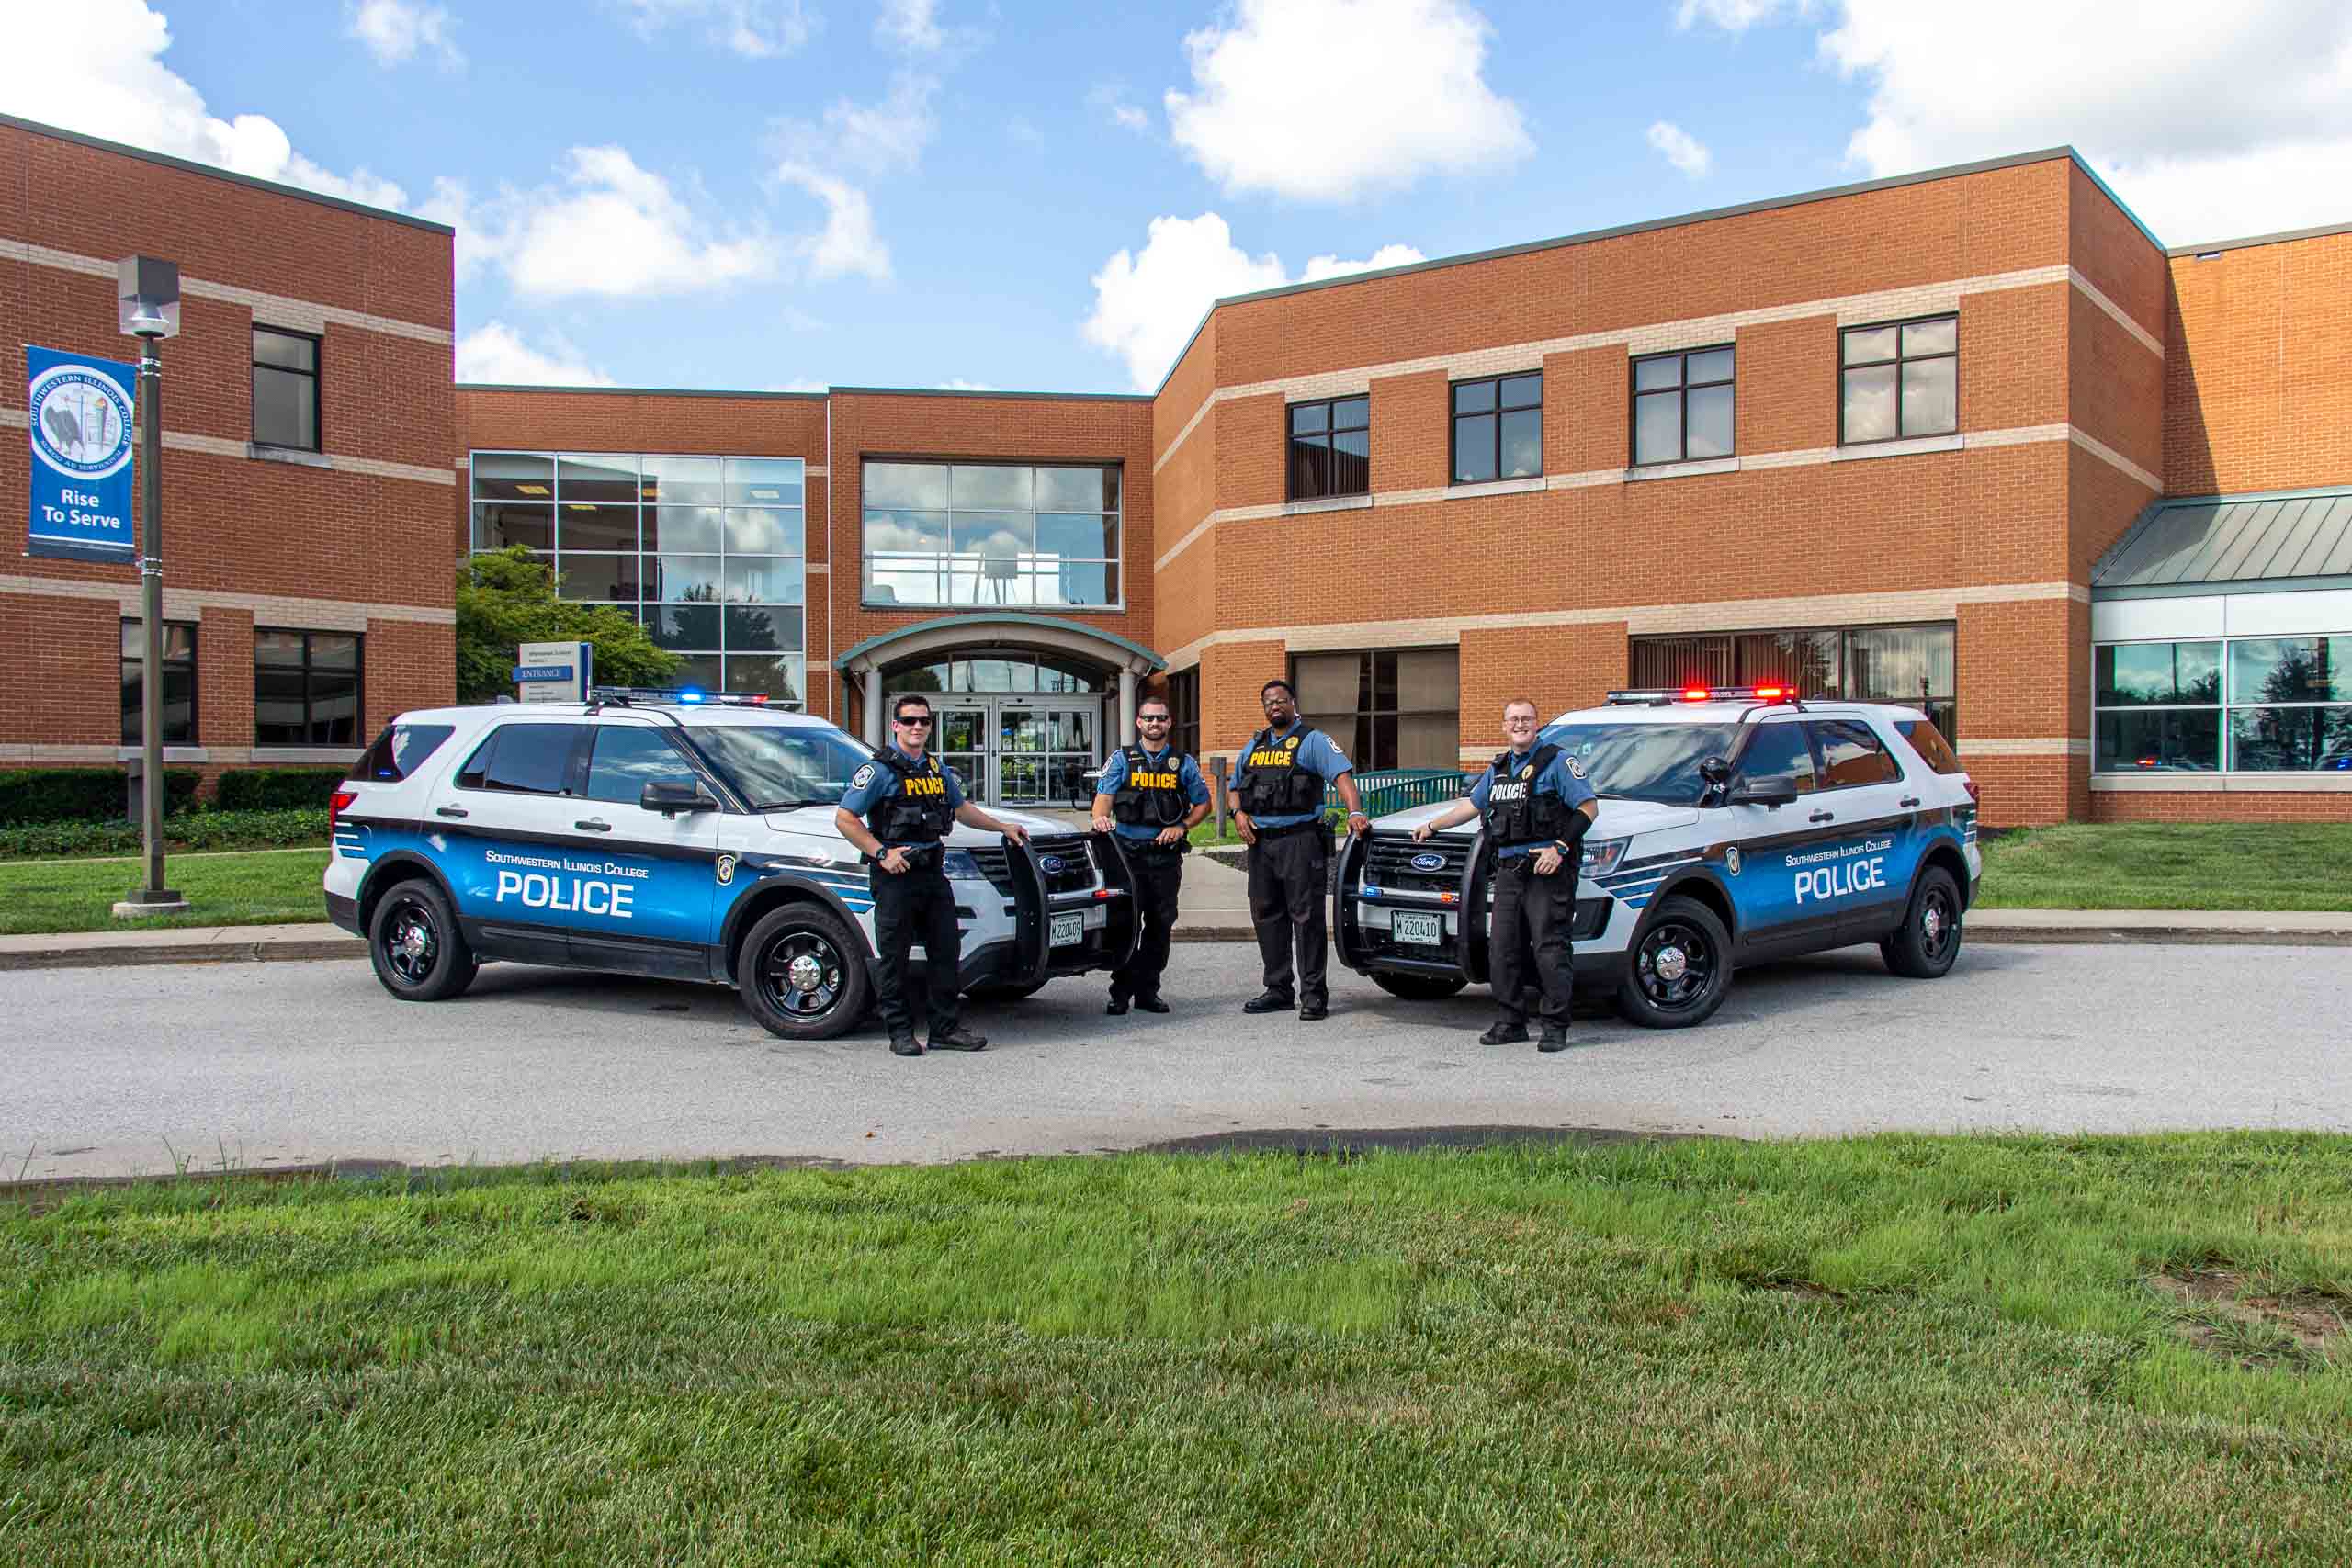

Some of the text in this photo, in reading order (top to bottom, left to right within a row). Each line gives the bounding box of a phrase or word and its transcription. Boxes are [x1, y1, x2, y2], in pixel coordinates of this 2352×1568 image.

[31, 375, 82, 427] SOUTHWESTERN
[84, 377, 119, 405] ILLINOIS
[61, 488, 100, 508] Rise
[42, 505, 121, 529] To Serve
[522, 668, 560, 678] ENTRANCE
[1250, 750, 1292, 766] POLICE
[904, 778, 944, 795] POLICE
[1131, 772, 1177, 789] POLICE
[1489, 782, 1528, 802] POLICE
[1416, 857, 1436, 867] Ford
[1794, 856, 1886, 904] POLICE
[495, 870, 634, 919] POLICE
